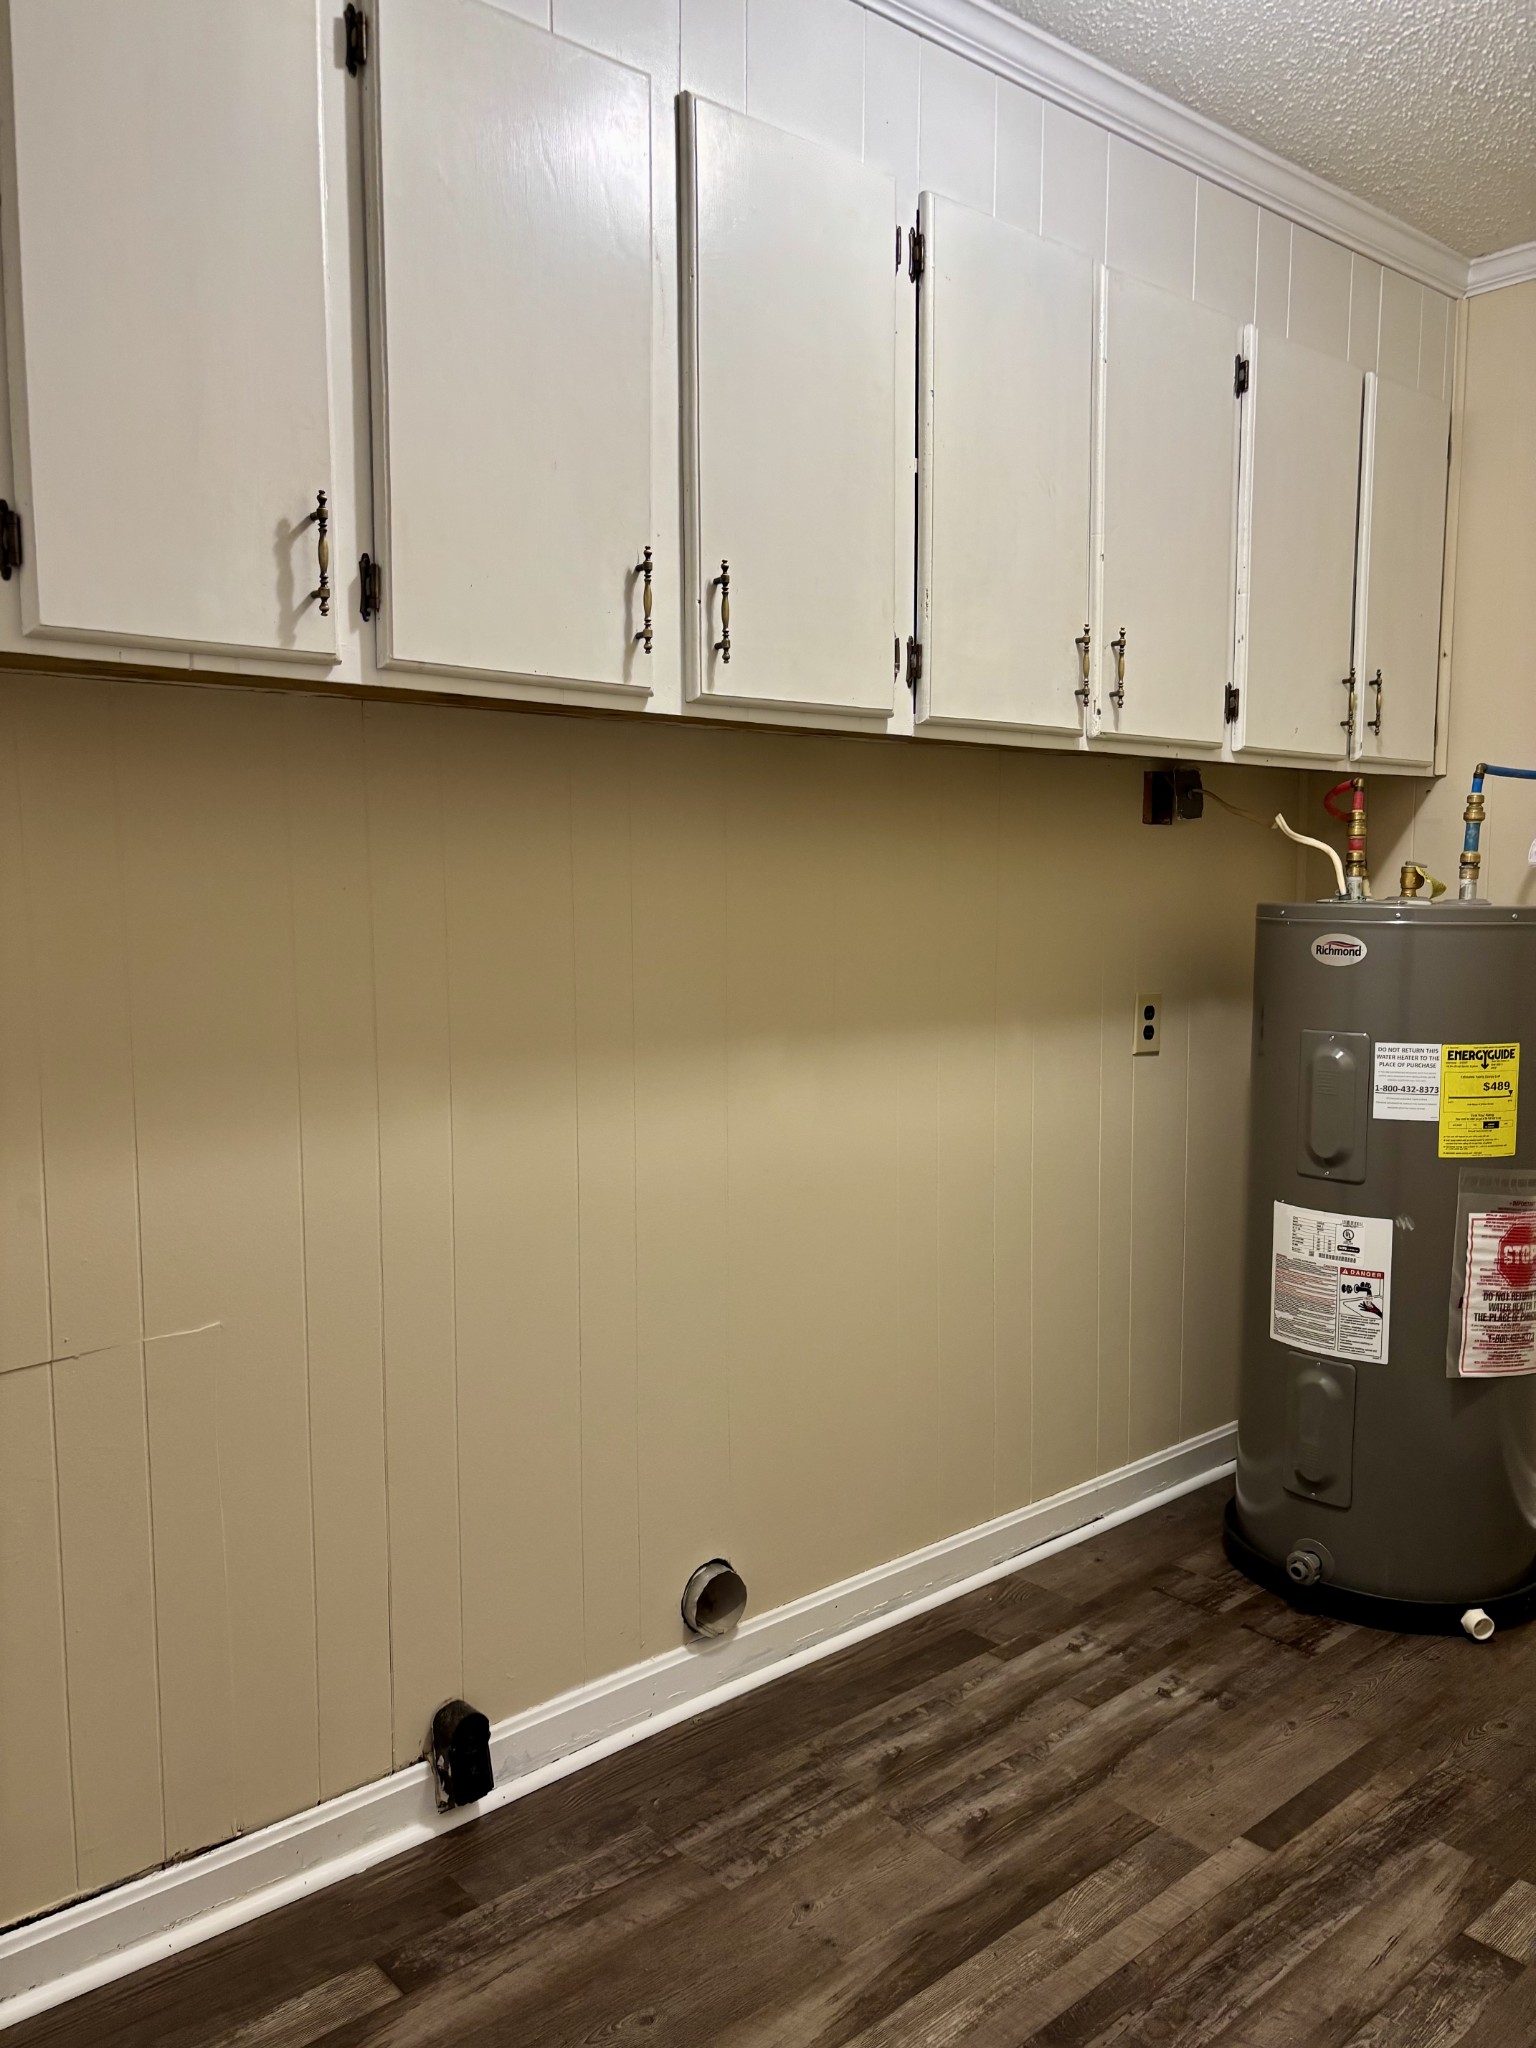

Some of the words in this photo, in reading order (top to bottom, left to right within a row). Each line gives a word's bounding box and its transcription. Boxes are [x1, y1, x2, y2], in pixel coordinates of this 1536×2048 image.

[1316, 944, 1361, 956] Richmond
[1447, 1049, 1516, 1060] ENERGYGUIDE
[1375, 1085, 1439, 1093] 1-800-432-8373
[1483, 1081, 1510, 1091] $489
[1350, 1269, 1382, 1278] DANGER
